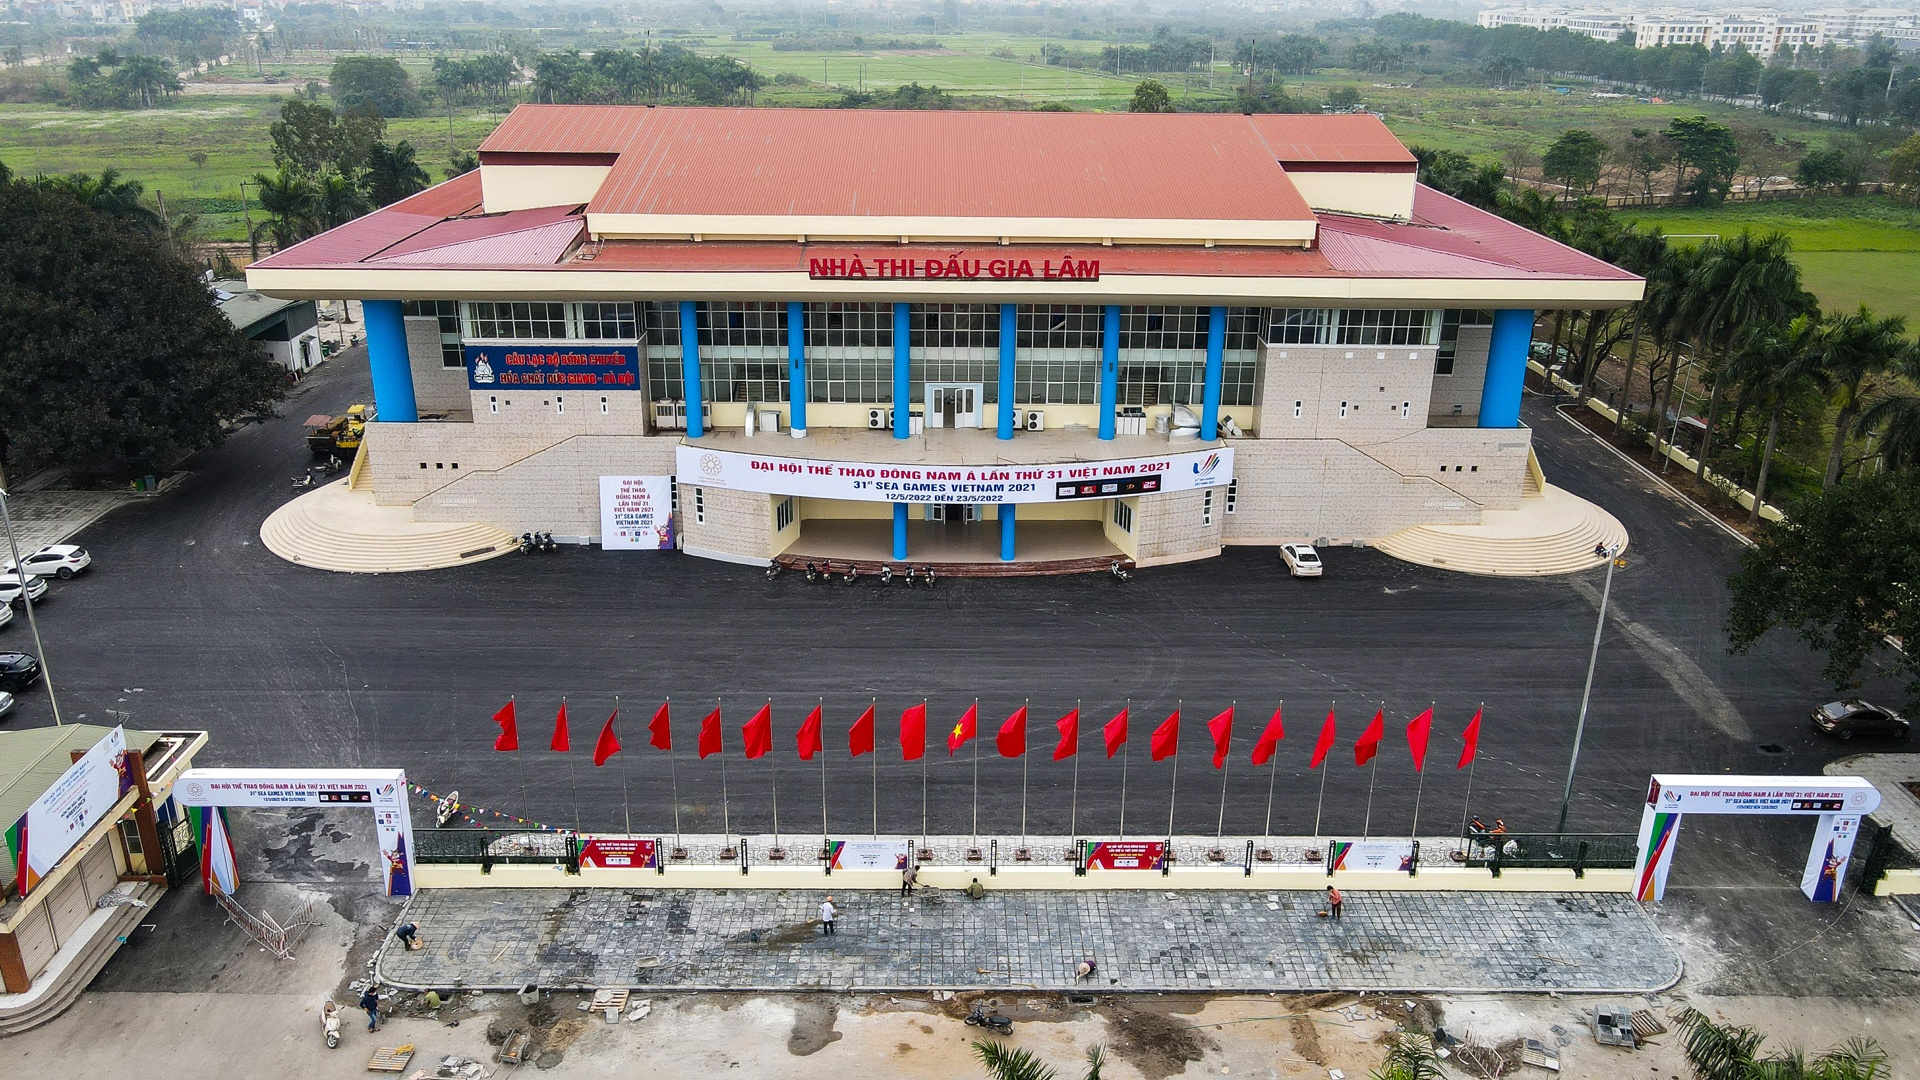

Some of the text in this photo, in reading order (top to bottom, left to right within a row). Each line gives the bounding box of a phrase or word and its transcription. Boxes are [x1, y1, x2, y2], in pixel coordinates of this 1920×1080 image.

[810, 250, 1099, 278] NHÀ THI ĐẤU GIA LÂM
[505, 351, 525, 366] CÂU
[526, 354, 545, 367] LẠC
[546, 351, 560, 367] BỘ
[561, 351, 588, 365] BÓNG
[500, 369, 520, 384] HÓA
[521, 369, 545, 384] CHẤT
[547, 369, 566, 384] ĐỨC
[567, 373, 597, 384] GIANG
[603, 370, 617, 384] HÀ
[618, 371, 634, 386] NỘI
[751, 460, 1170, 481] ĐẠI HỘI THỂ THAO ĐÔNG NAM Á LẦN THỨ 31 VIỆT NAM 2021
[853, 480, 1035, 493] 31st SEA GAMES VIETNAM 2021
[885, 492, 1003, 502] 12/5/2022 ĐẾN 23/5/2022
